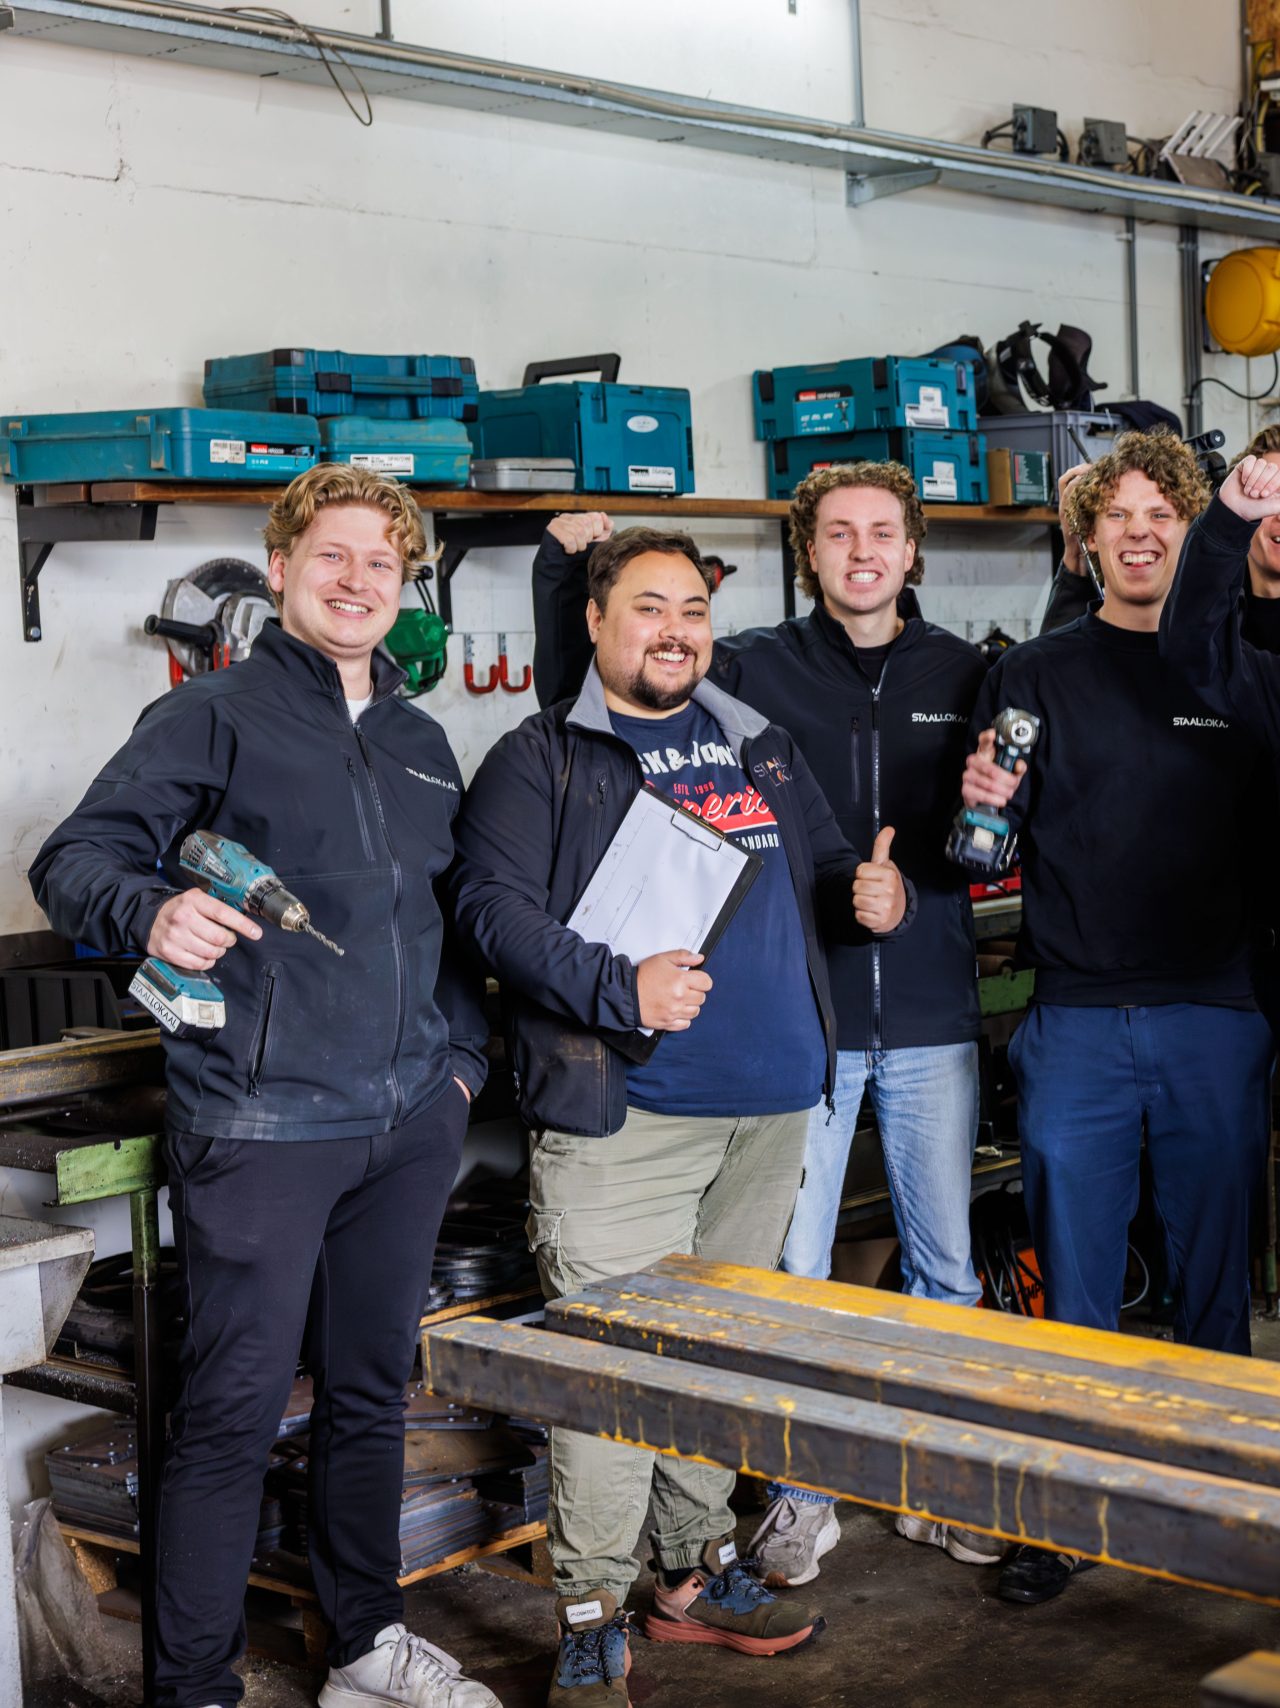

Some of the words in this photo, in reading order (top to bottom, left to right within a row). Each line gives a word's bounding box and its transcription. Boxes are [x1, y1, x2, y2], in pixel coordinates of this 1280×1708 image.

[911, 712, 968, 724] STAALLOKA
[1172, 716, 1229, 728] STAALLOKA
[131, 980, 177, 1030] STAALLOKAAL
